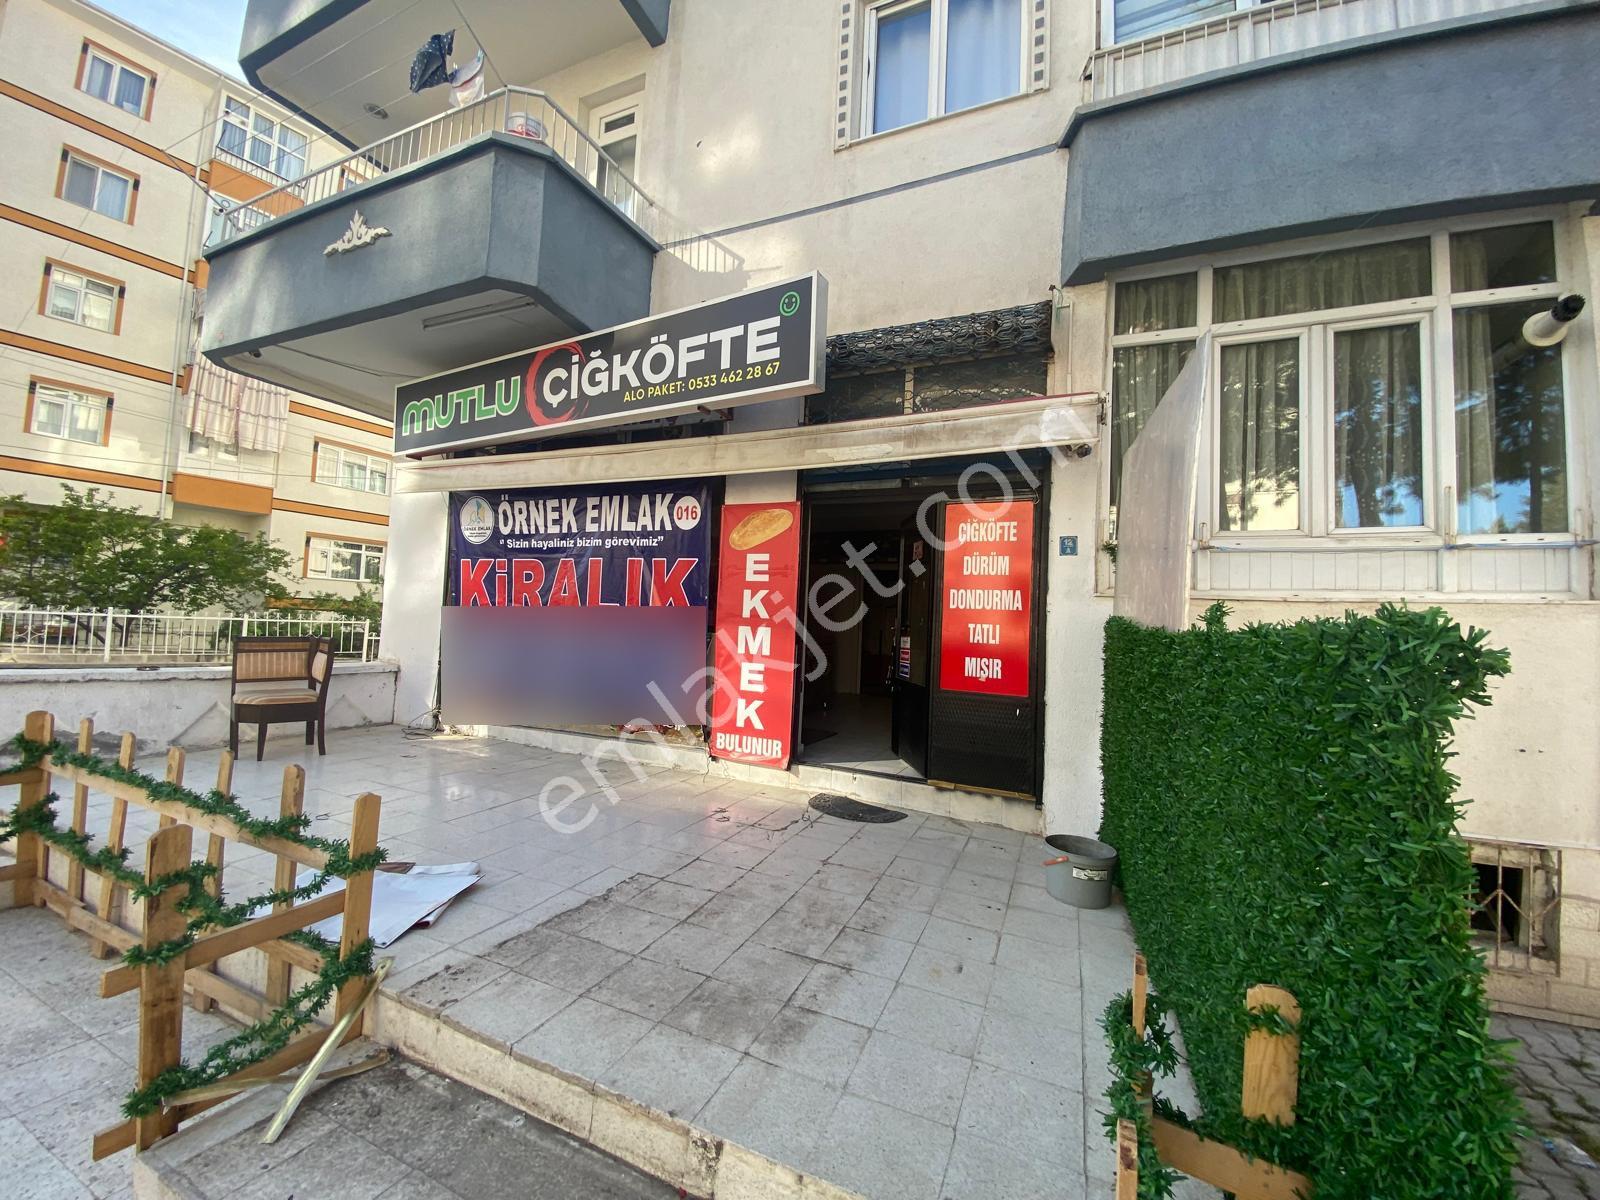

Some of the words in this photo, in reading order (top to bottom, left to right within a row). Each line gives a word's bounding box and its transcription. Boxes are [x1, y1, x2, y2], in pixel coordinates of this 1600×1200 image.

[402, 375, 521, 436] MUTLU
[543, 315, 781, 409] ÇİĞKÖFTE
[624, 389, 645, 402] ALO
[648, 381, 685, 397] PAKET:
[688, 374, 717, 390] 0533
[720, 369, 743, 384] 462
[746, 365, 762, 380] 28
[765, 361, 780, 376] 67
[498, 494, 578, 536] ÖRNEK
[585, 493, 674, 534] EMLAK
[676, 504, 698, 521] 016
[531, 537, 574, 549] hayaliniz
[576, 536, 602, 547] bizim
[958, 517, 1018, 544] ÇİĞKÖFTE
[1063, 538, 1073, 546] 12
[963, 551, 1010, 576] DÜRÜM
[949, 588, 1023, 611] DONDURMA
[736, 553, 771, 730] EKMEK
[968, 623, 1000, 645] TATLI
[964, 656, 1002, 682] MIŞIR
[716, 733, 782, 759] BULUNUR
